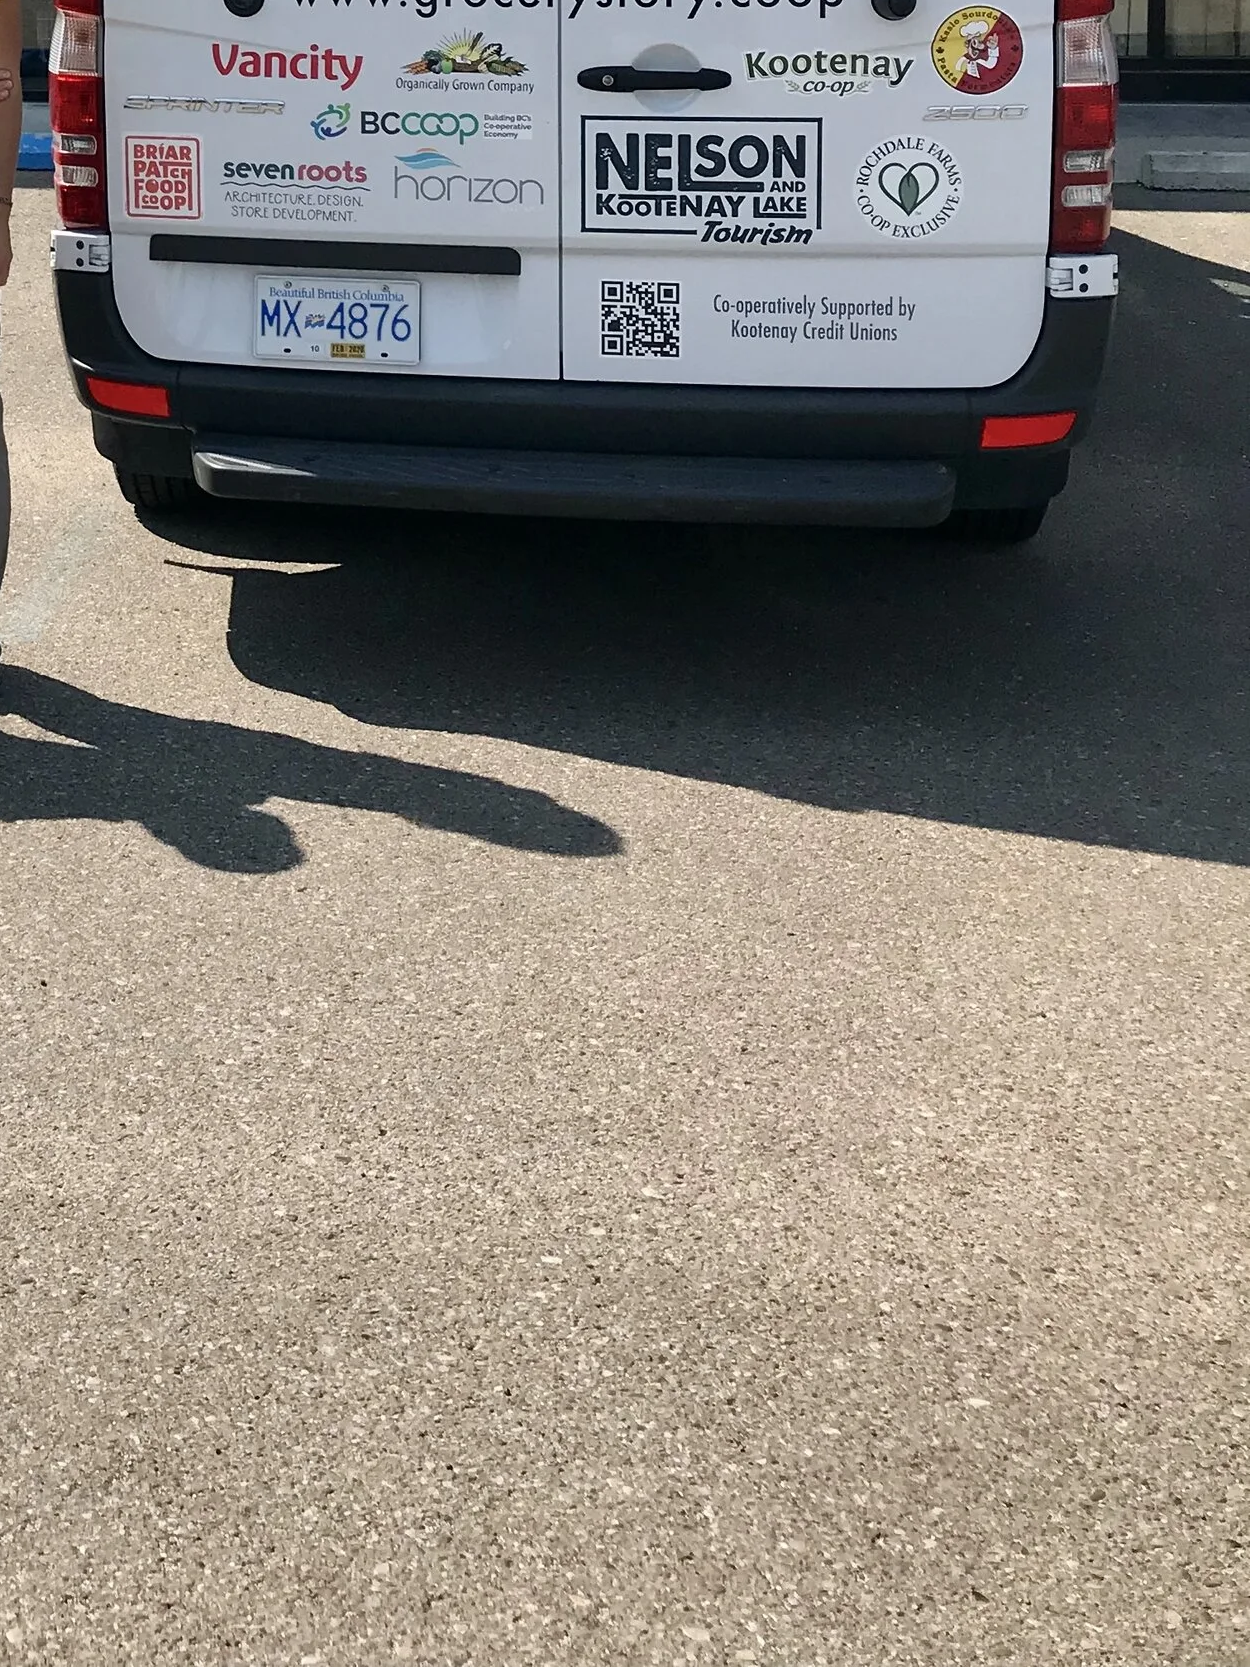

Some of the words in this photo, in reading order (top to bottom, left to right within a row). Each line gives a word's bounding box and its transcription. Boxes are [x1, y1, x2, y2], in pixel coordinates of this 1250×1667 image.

[212, 43, 364, 91] Vancity
[746, 51, 914, 85] Kootenay
[937, 56, 958, 84] Pasta
[396, 77, 450, 91] Organically
[452, 78, 485, 91] Grown
[487, 80, 535, 94] Company
[802, 79, 855, 96] co-op
[123, 95, 286, 115] SPRINTER
[922, 104, 1029, 121] 2500
[483, 114, 515, 123] Building
[483, 131, 519, 139] Economy
[133, 143, 192, 160] BRIAR
[133, 161, 192, 179] PATCH
[595, 133, 806, 193] NELSON
[856, 137, 925, 186] ROCHDALE
[927, 142, 962, 186] FARMS
[134, 179, 187, 195] FOOD
[394, 165, 545, 205] horizon
[769, 180, 806, 193] AND
[224, 191, 315, 206] ARCHITECTURE.
[318, 195, 364, 207] DESIGN.
[596, 193, 746, 218] KOOTENAY
[753, 196, 807, 218] LAKE
[231, 205, 269, 219] STORE
[892, 194, 960, 238] EXCLUSIVE
[700, 220, 813, 245] Tourism
[269, 286, 315, 299] Beautiful
[317, 288, 351, 300] British
[352, 290, 405, 302] Columbia
[713, 294, 816, 319] Co-operatively
[820, 296, 894, 320] Supported
[898, 296, 917, 321] by
[261, 299, 302, 338] MX
[326, 302, 411, 342] 4876
[731, 319, 798, 343] Kootenay
[803, 320, 845, 341] Credit
[849, 322, 898, 341] Unions
[310, 345, 320, 353] 10
